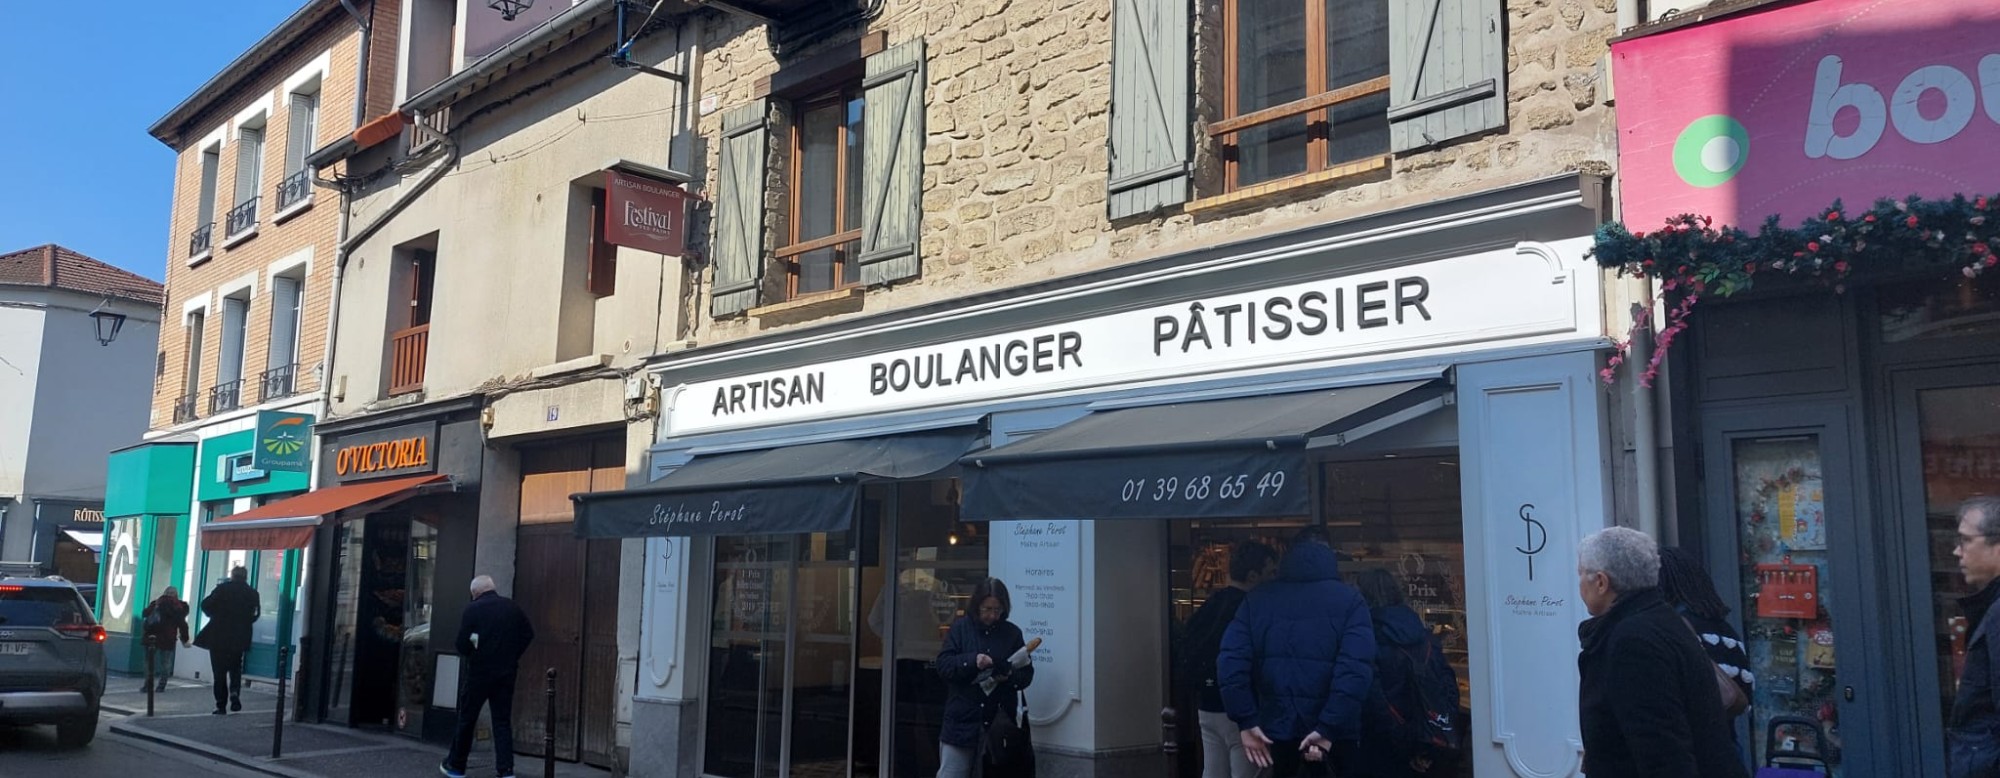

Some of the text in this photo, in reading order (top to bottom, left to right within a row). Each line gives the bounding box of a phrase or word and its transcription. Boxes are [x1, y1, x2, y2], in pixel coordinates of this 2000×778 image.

[1804, 53, 2000, 160] bo
[614, 178, 680, 199] ARTISAN BOULANGER
[623, 200, 672, 231] Festival
[712, 275, 1432, 417] ARTISAN BOULANGER PÂTISSIER
[336, 436, 427, 476] O'VICTORIA
[1122, 471, 1285, 501] 01 39 68 65 49
[649, 503, 701, 533] Stéphane
[1025, 568, 1055, 577] Horaires
[1408, 583, 1438, 597] Prix
